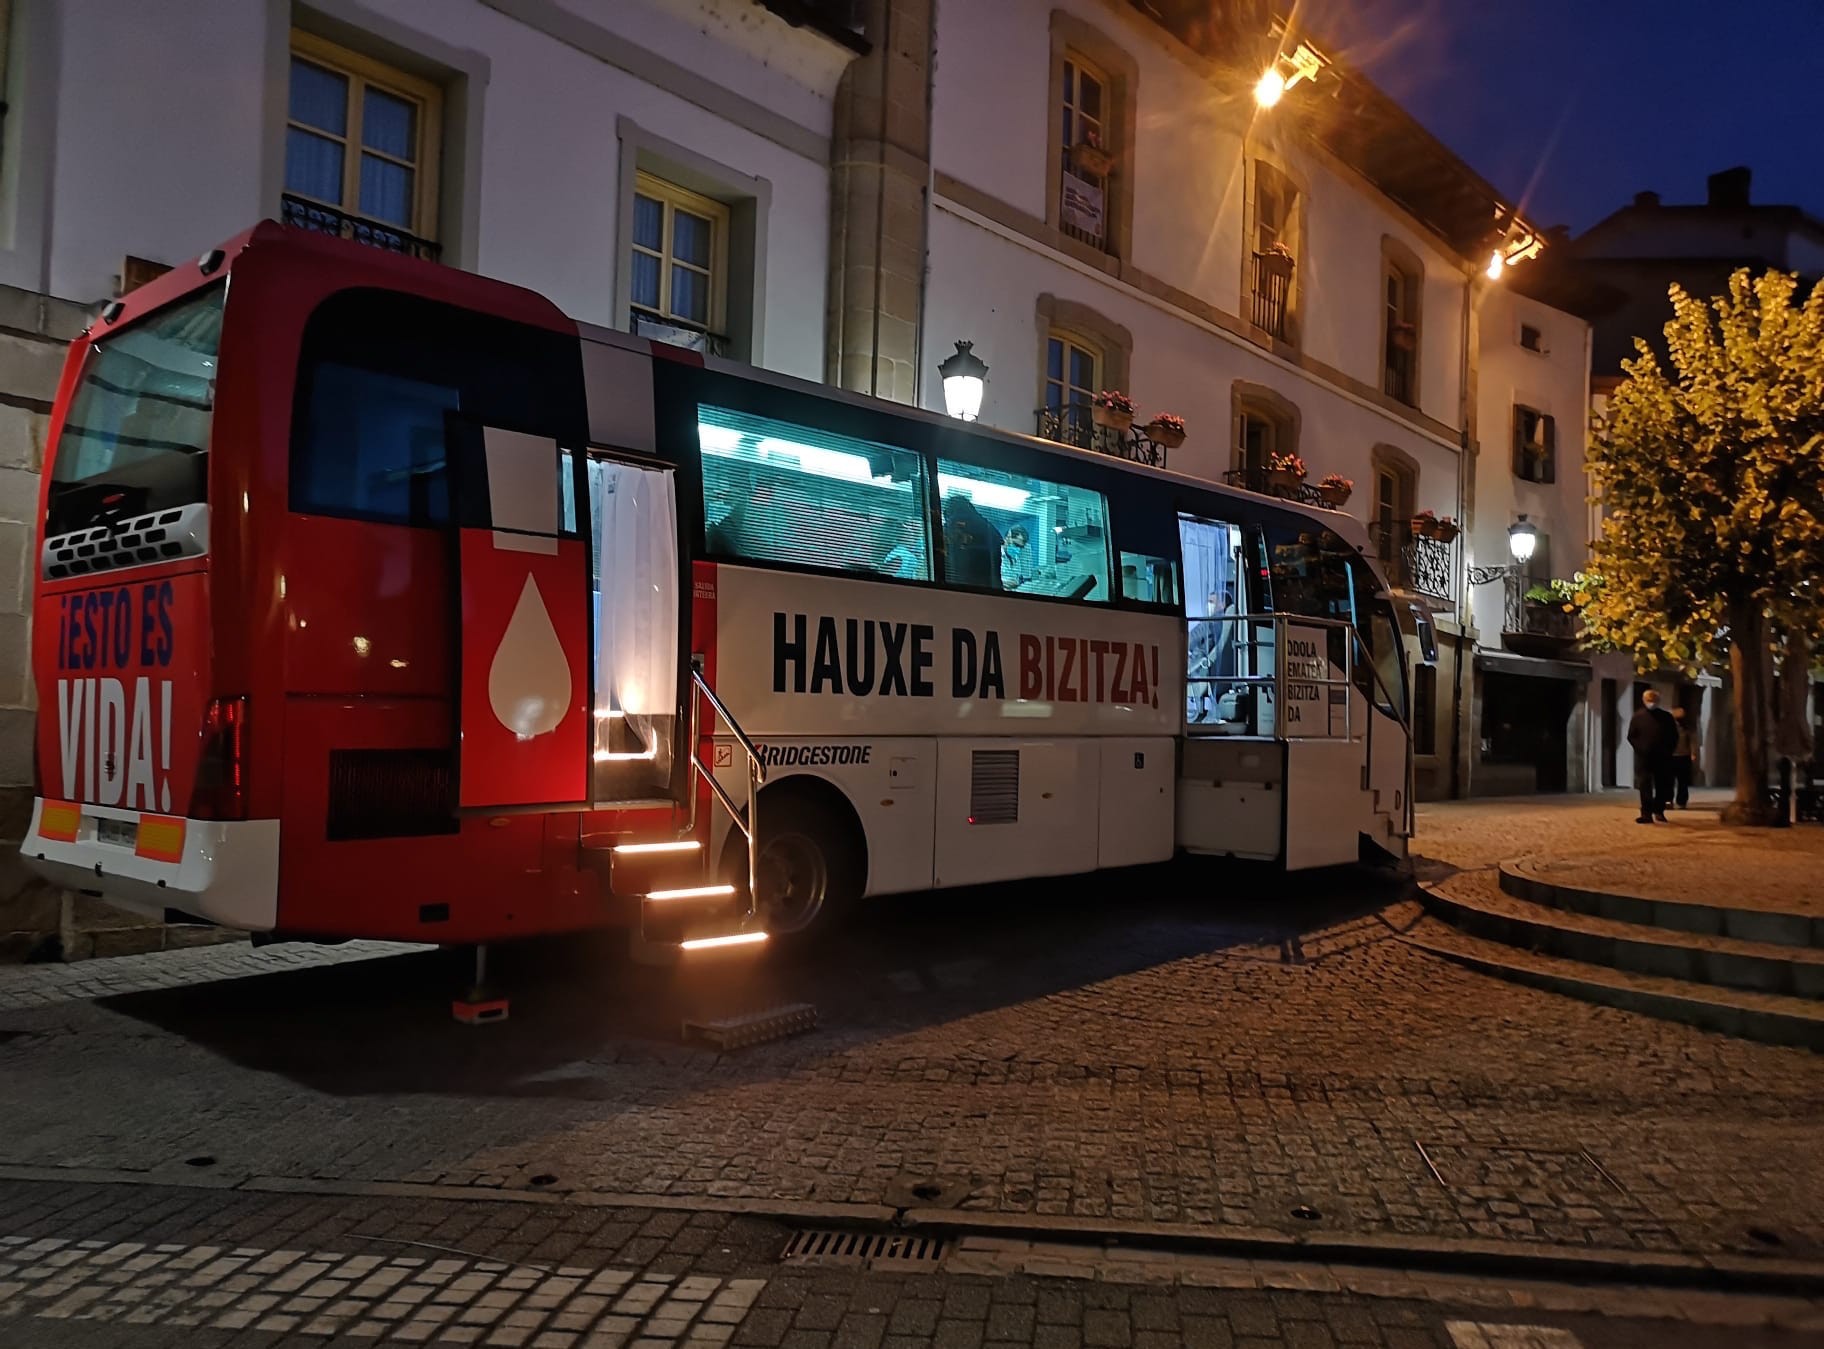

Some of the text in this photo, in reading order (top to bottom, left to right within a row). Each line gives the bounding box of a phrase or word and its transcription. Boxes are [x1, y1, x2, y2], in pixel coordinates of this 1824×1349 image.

[58, 580, 174, 671] ¡ESTO ES
[772, 611, 1160, 710] HAUXE DA BIZITZA!
[1287, 684, 1320, 701] BIZITZA
[1287, 705, 1302, 722] DA
[57, 676, 173, 813] VIDA!
